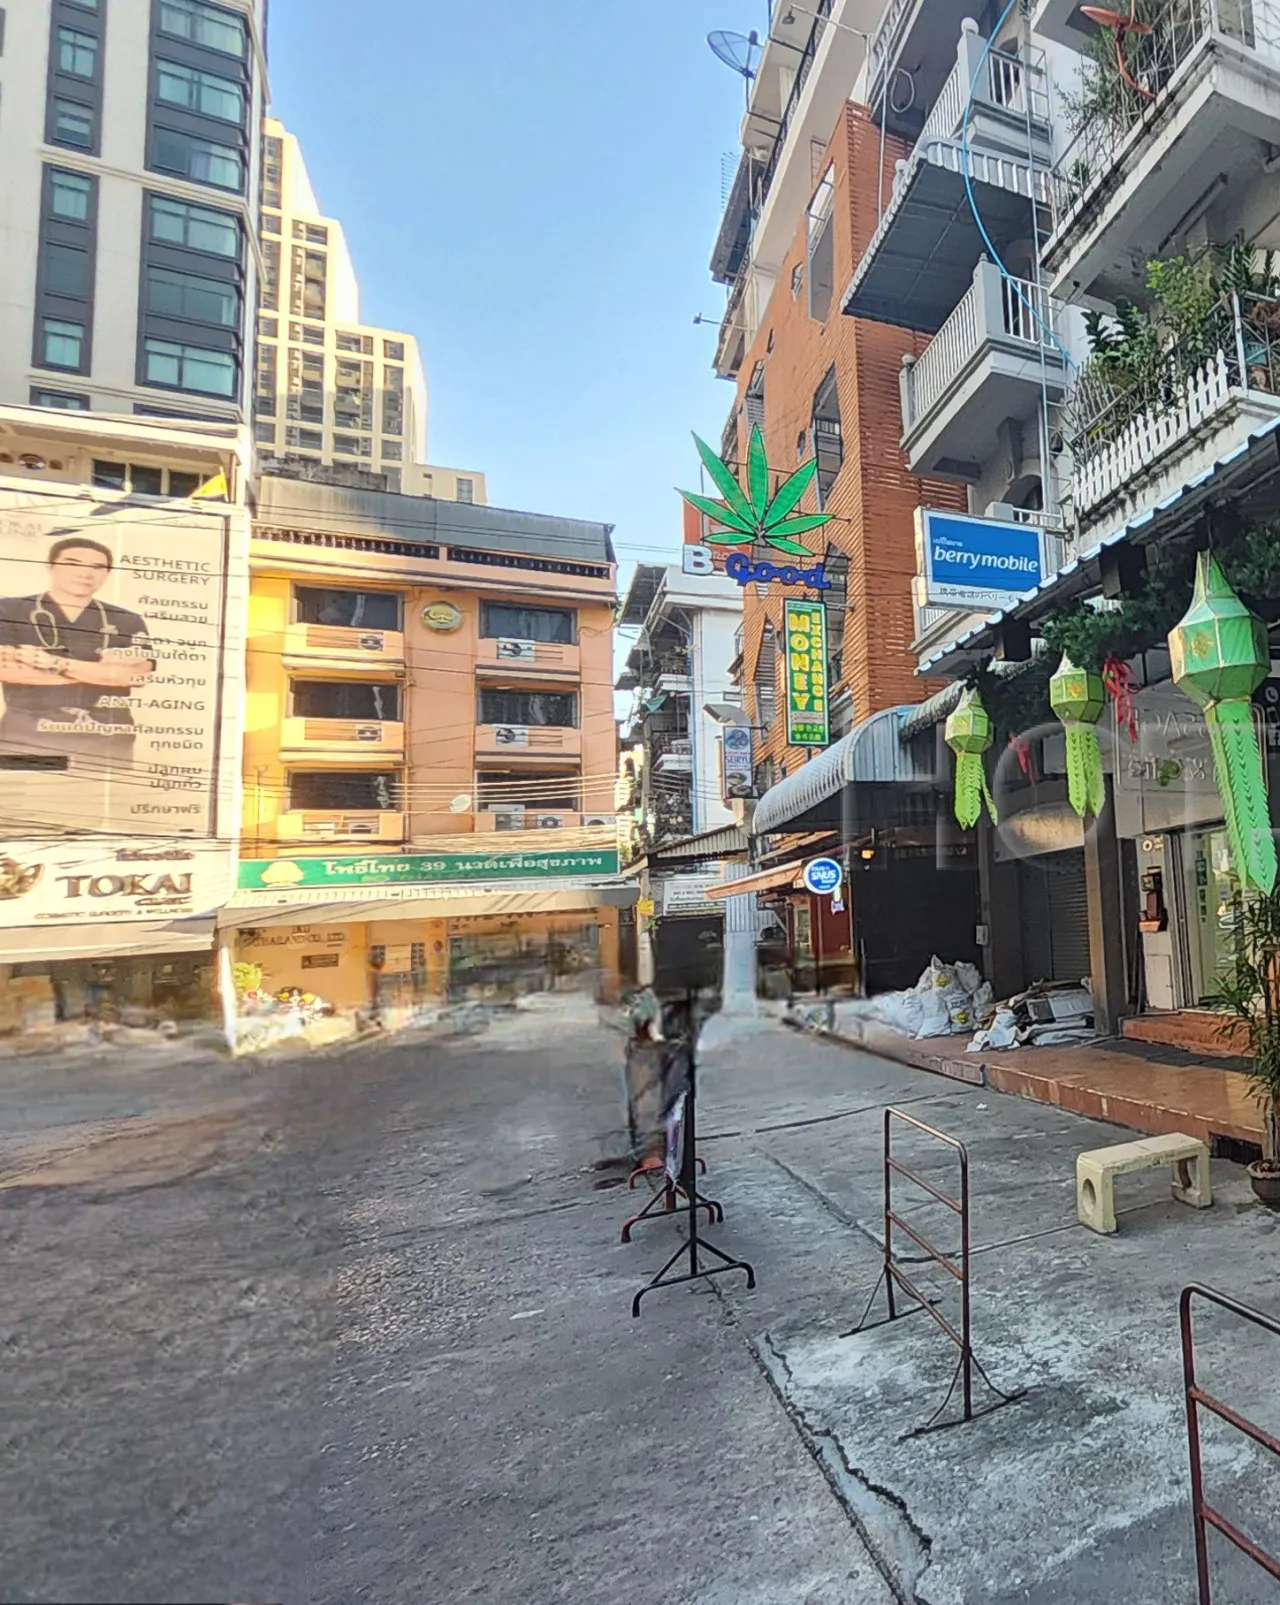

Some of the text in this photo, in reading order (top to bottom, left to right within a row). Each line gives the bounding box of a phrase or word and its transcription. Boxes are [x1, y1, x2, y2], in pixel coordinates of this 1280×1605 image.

[120, 555, 211, 572] AESTHETIC
[683, 544, 715, 576] B
[132, 570, 210, 585] SURGERY
[138, 595, 209, 611] ศัลยกรรม
[788, 612, 811, 711] MONEY
[810, 611, 824, 712] EXCHANGE
[99, 697, 206, 711] ANTI-AGING
[420, 861, 446, 871] 39
[455, 855, 602, 872] นวดเพื่อสุขภาพ
[55, 872, 193, 898] TOKAI
